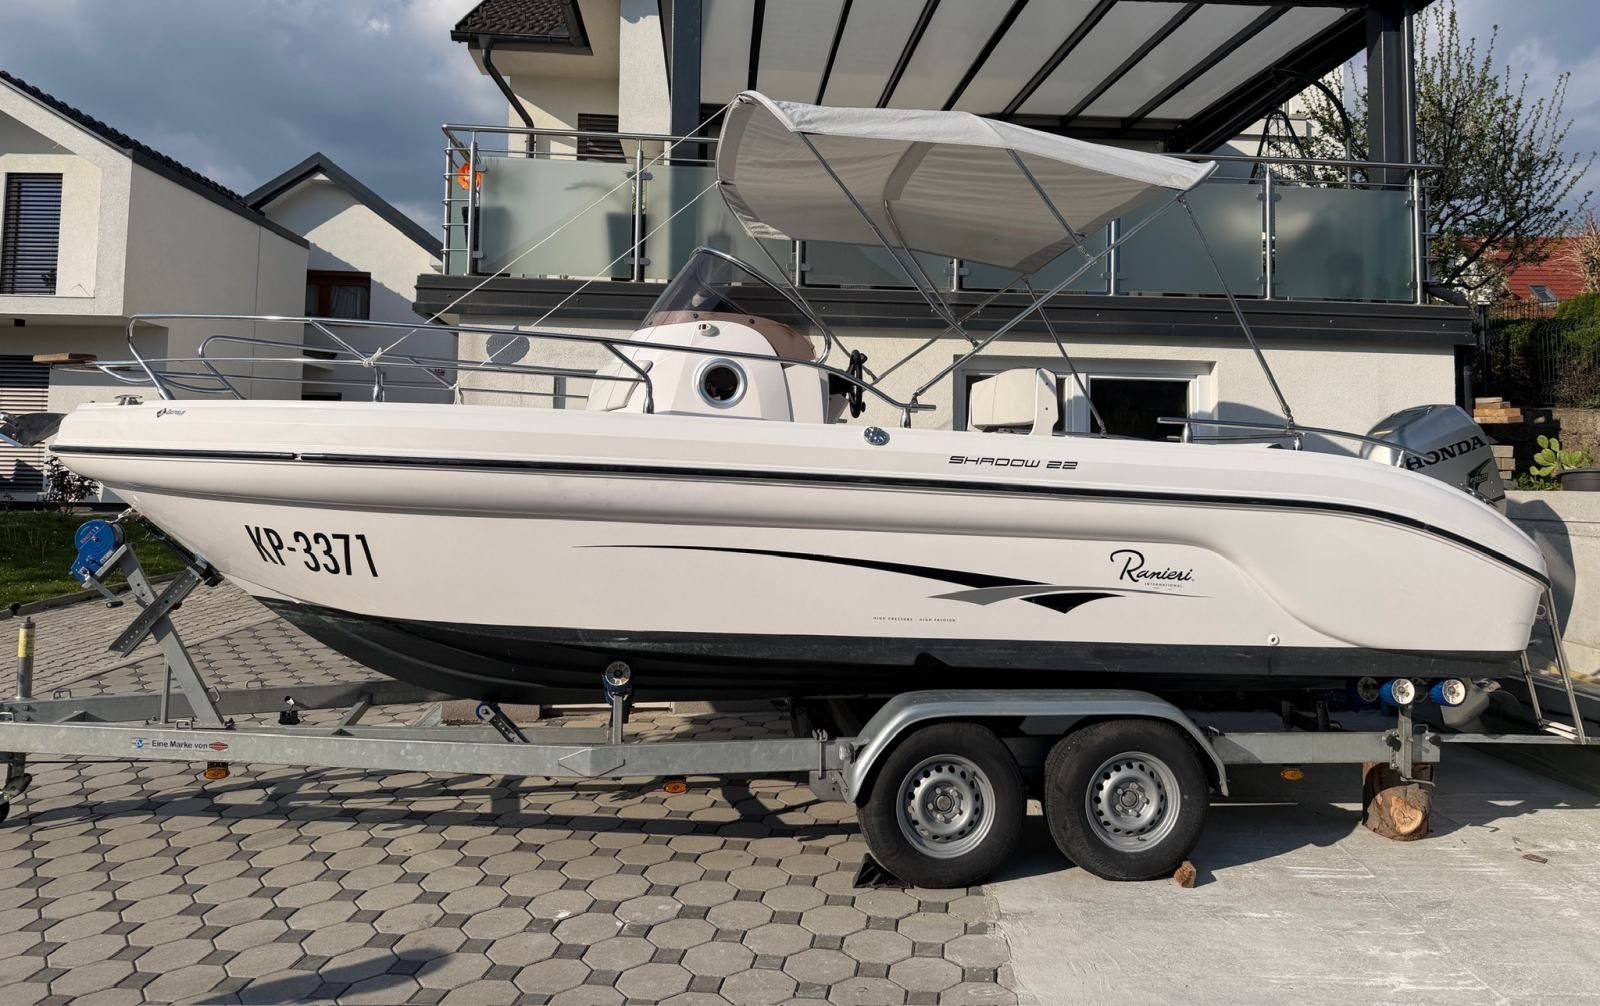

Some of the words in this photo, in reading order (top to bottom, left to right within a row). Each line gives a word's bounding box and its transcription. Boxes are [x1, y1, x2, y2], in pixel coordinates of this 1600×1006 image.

[948, 455, 1041, 468] SHADOW
[1046, 460, 1078, 470] 22
[1405, 434, 1487, 471] HONDA
[244, 524, 379, 577] KP-3371
[1109, 549, 1193, 583] Ranieri
[151, 739, 169, 748] Eine
[169, 740, 193, 749] Marke
[194, 742, 208, 750] von
